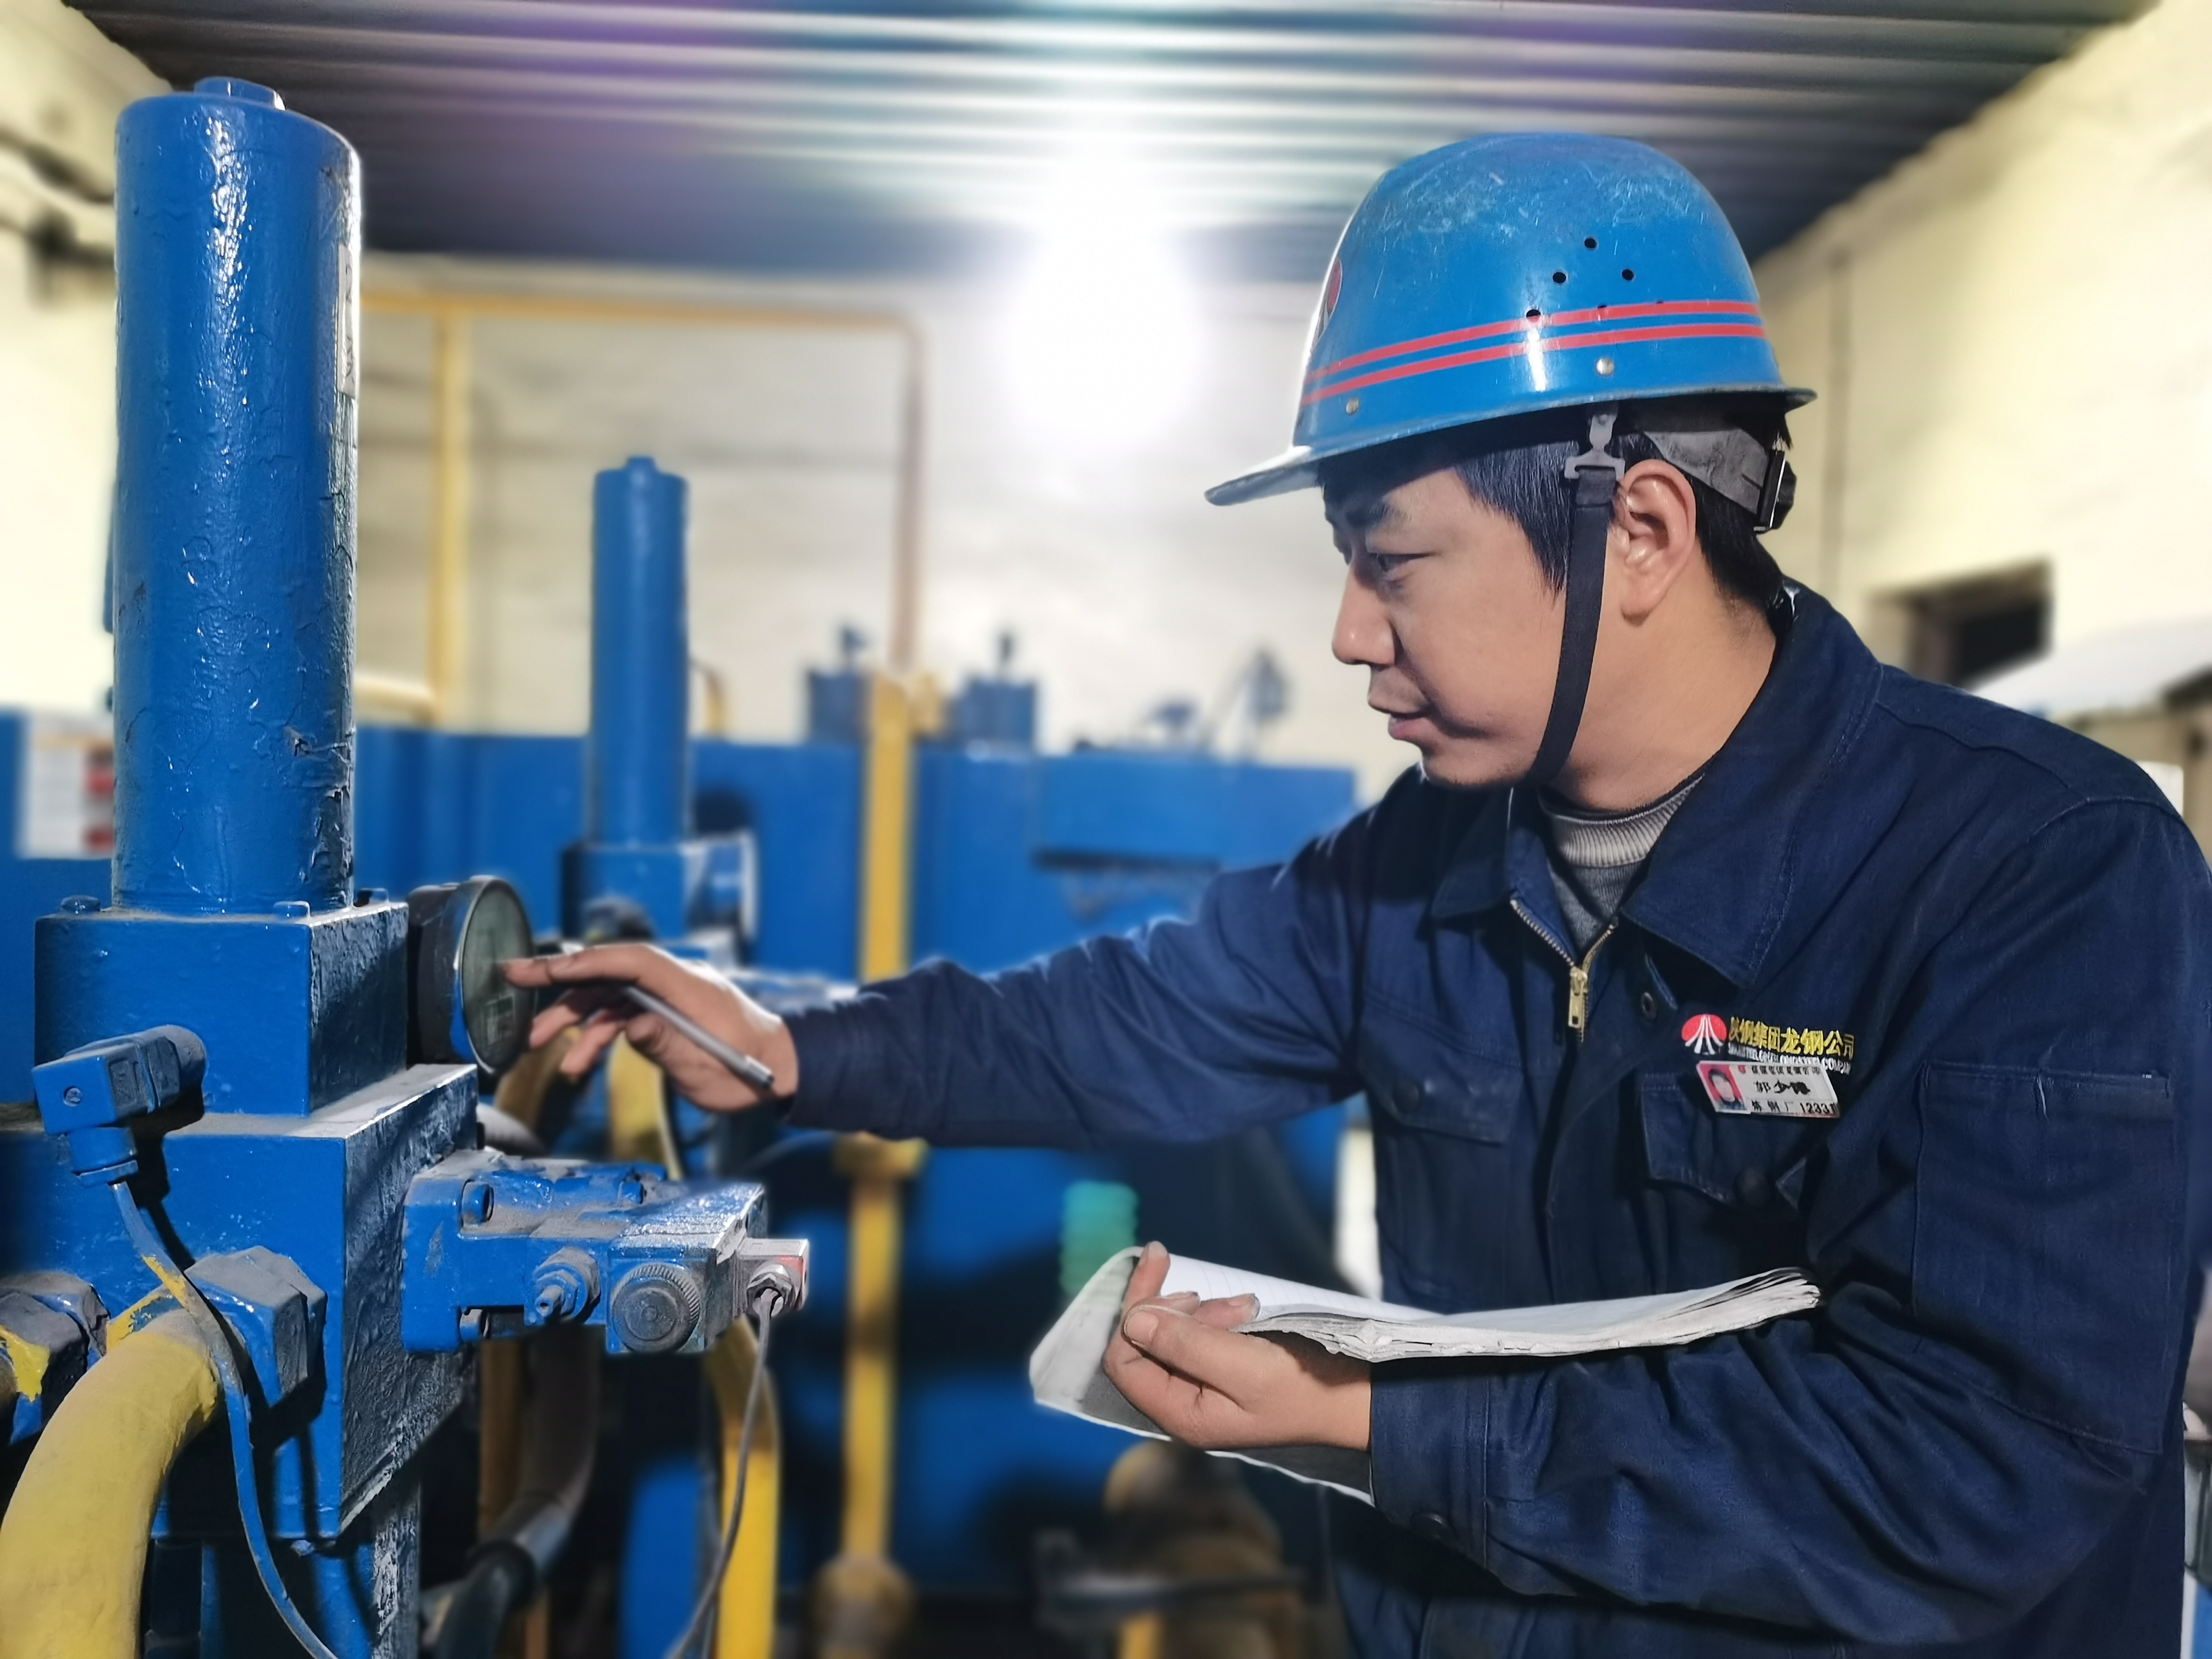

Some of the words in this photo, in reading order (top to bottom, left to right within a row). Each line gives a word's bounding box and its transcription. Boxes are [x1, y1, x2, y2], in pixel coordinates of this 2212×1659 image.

[1729, 1016, 1854, 1060] 陕钢集团龙钢公司
